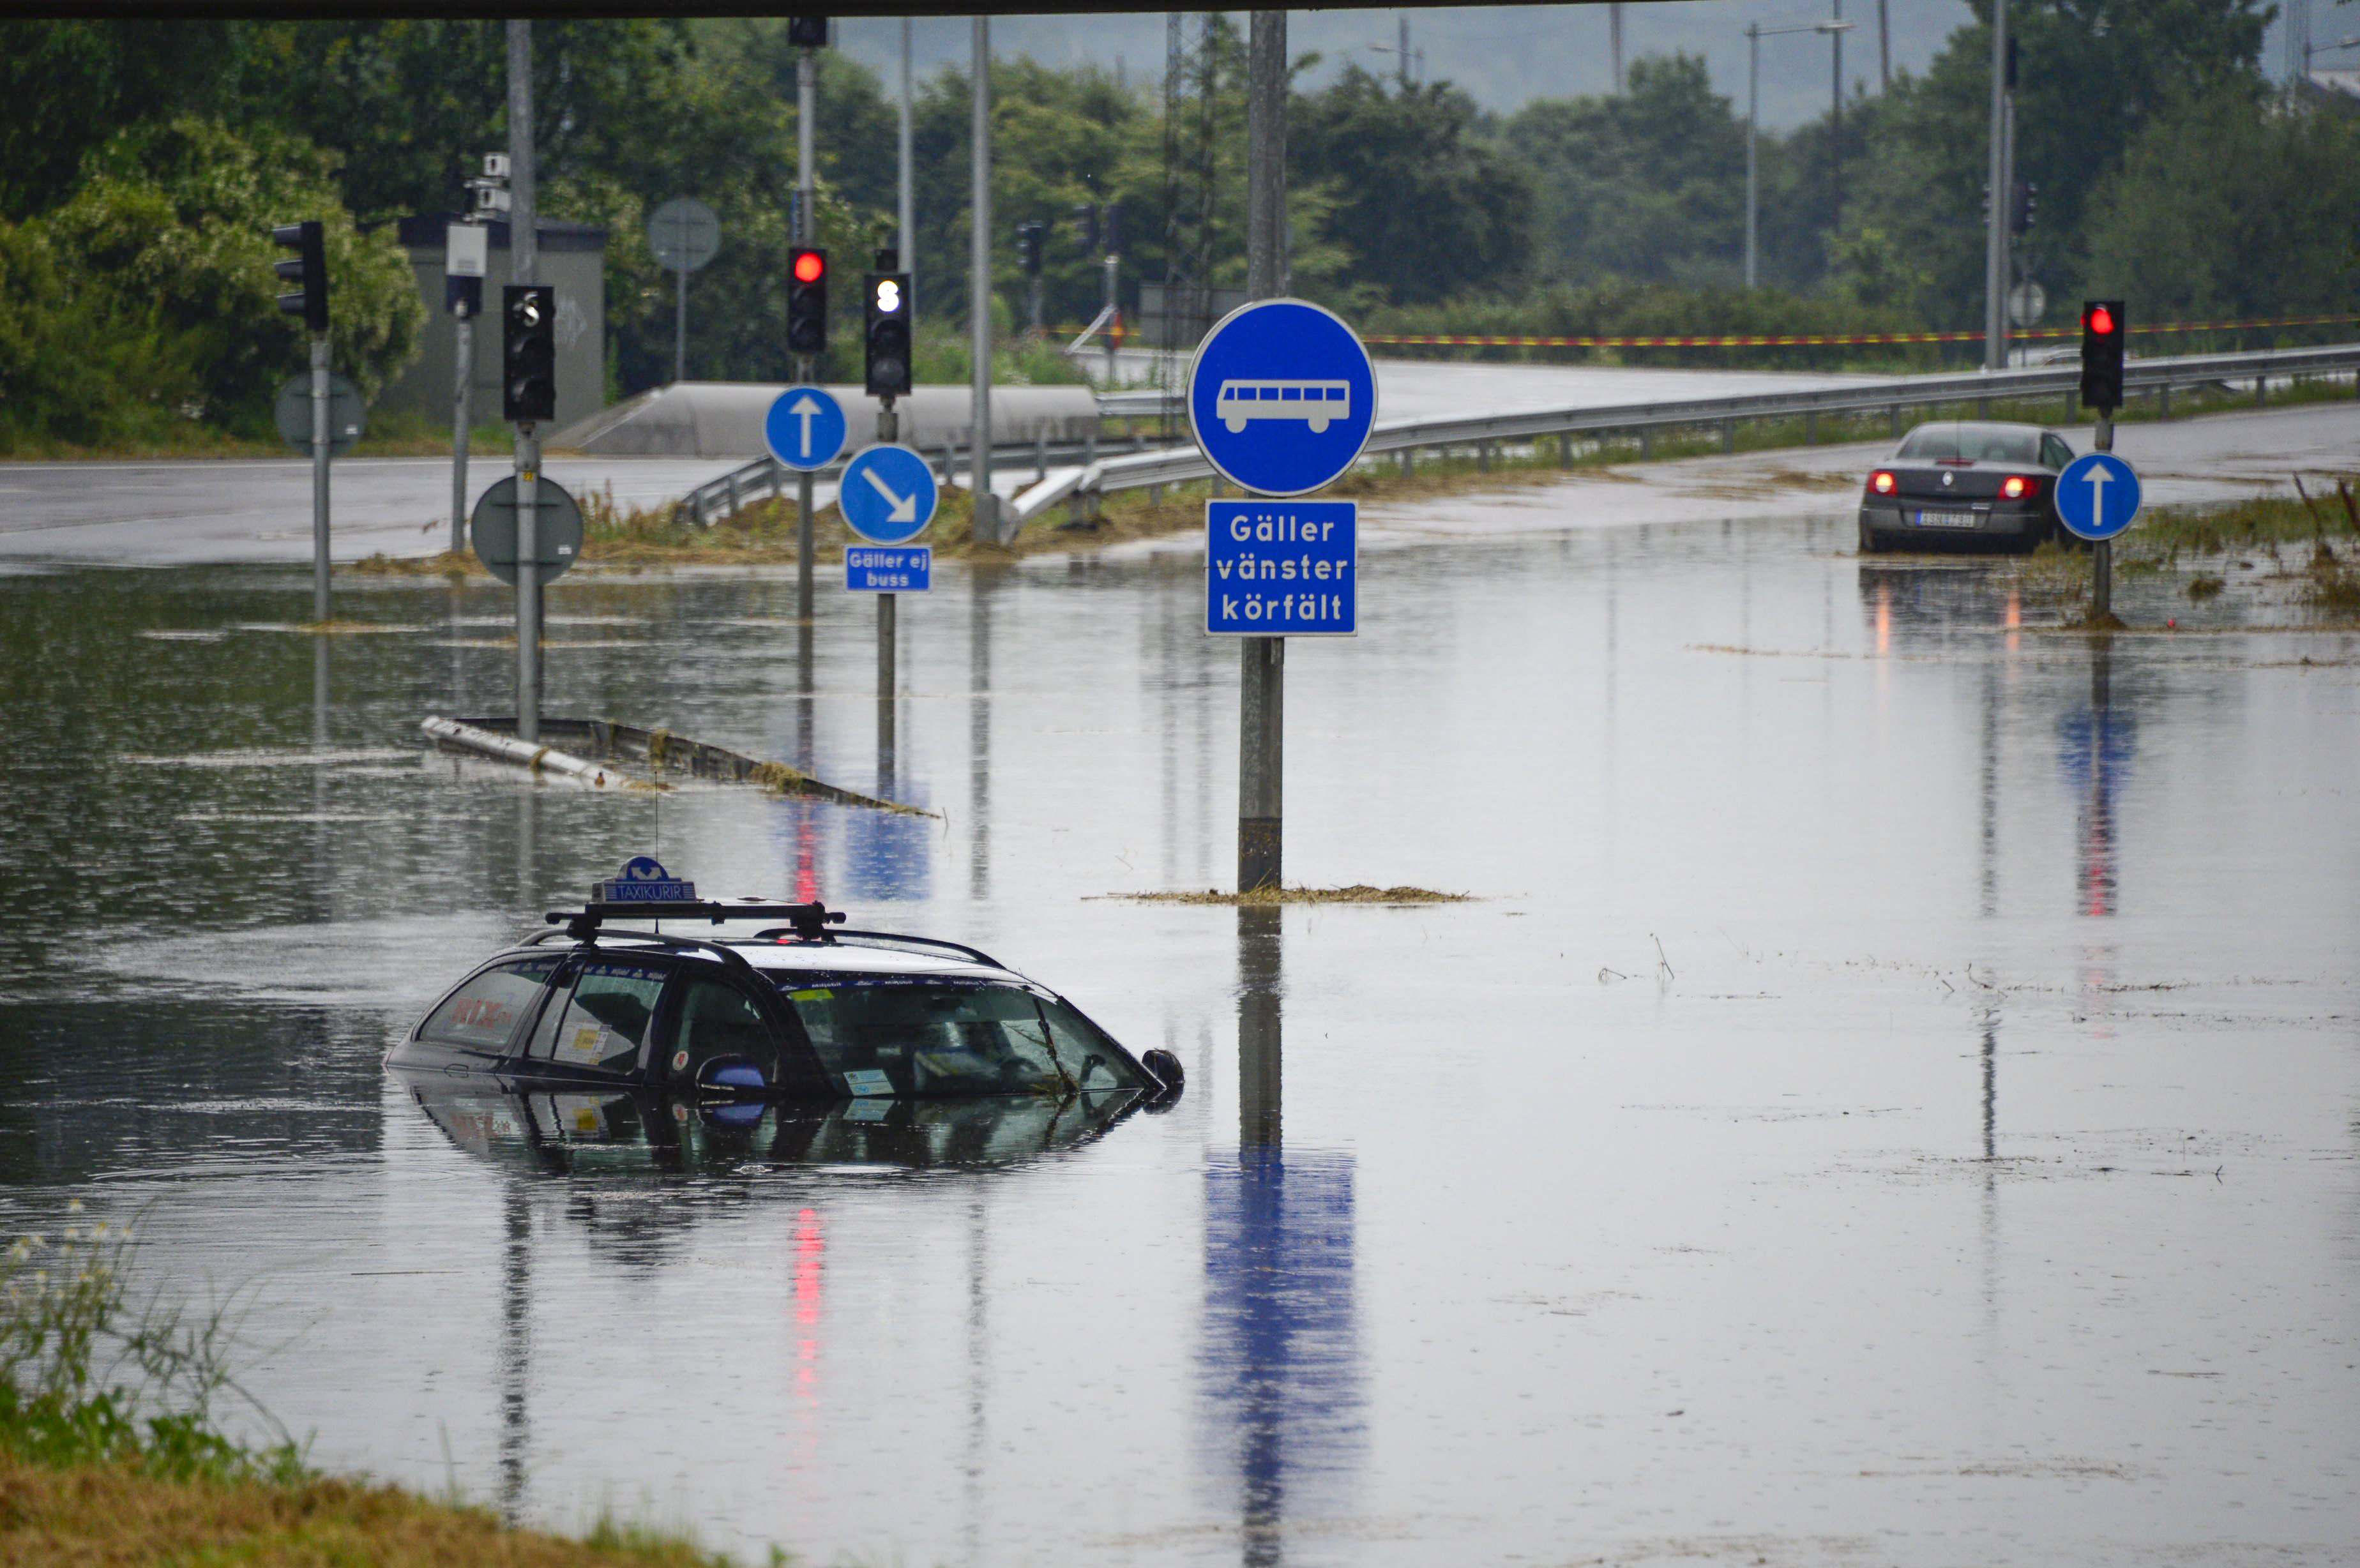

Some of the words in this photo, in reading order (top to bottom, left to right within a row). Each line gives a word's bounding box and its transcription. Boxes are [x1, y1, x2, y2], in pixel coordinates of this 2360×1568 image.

[1230, 515, 1335, 541] Gäller
[849, 552, 904, 568] Gäller
[910, 554, 927, 571] ej
[1216, 553, 1348, 580] vänster
[867, 572, 909, 586] buss
[1222, 594, 1342, 621] körfält
[617, 885, 683, 900] TAXIKURIR
[450, 997, 502, 1028] RIX
